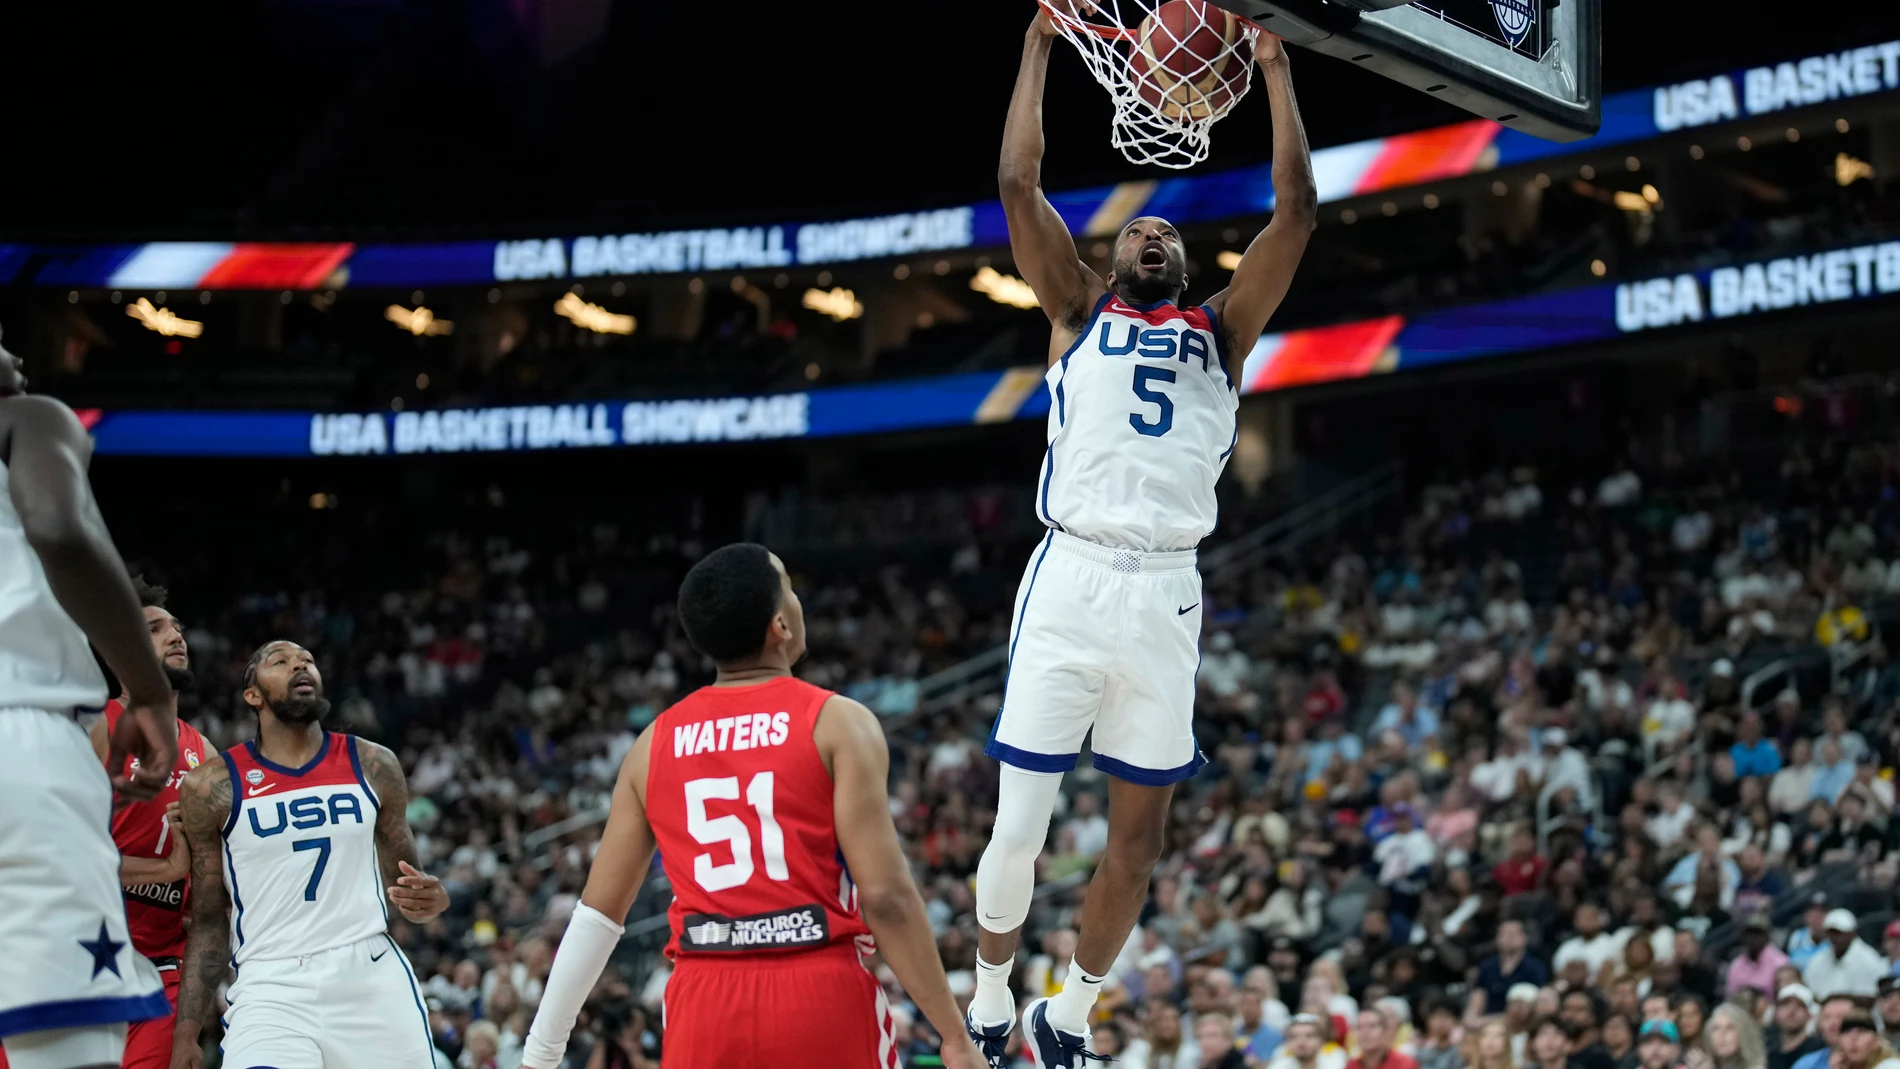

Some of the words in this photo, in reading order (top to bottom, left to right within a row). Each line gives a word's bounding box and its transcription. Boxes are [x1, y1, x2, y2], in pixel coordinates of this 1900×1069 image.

[1653, 74, 1739, 132] USA
[1744, 39, 1900, 116] BASKET
[494, 238, 566, 281] USA
[571, 225, 791, 277] BASKETBALL
[796, 206, 974, 264] SHOWCASE
[1615, 273, 1702, 333] USA
[1709, 240, 1900, 318] BASKETB
[1099, 321, 1209, 374] USA
[310, 413, 388, 455] USA
[393, 403, 615, 455] BASKETBALL
[622, 392, 809, 445] SHOWCASE
[1129, 364, 1176, 438] 5
[674, 712, 789, 757] WATERS
[247, 793, 363, 838] USA
[684, 771, 789, 892] 51
[292, 837, 331, 902] 7
[731, 924, 824, 946] MULTIPLES
[735, 910, 813, 932] SEGUROS
